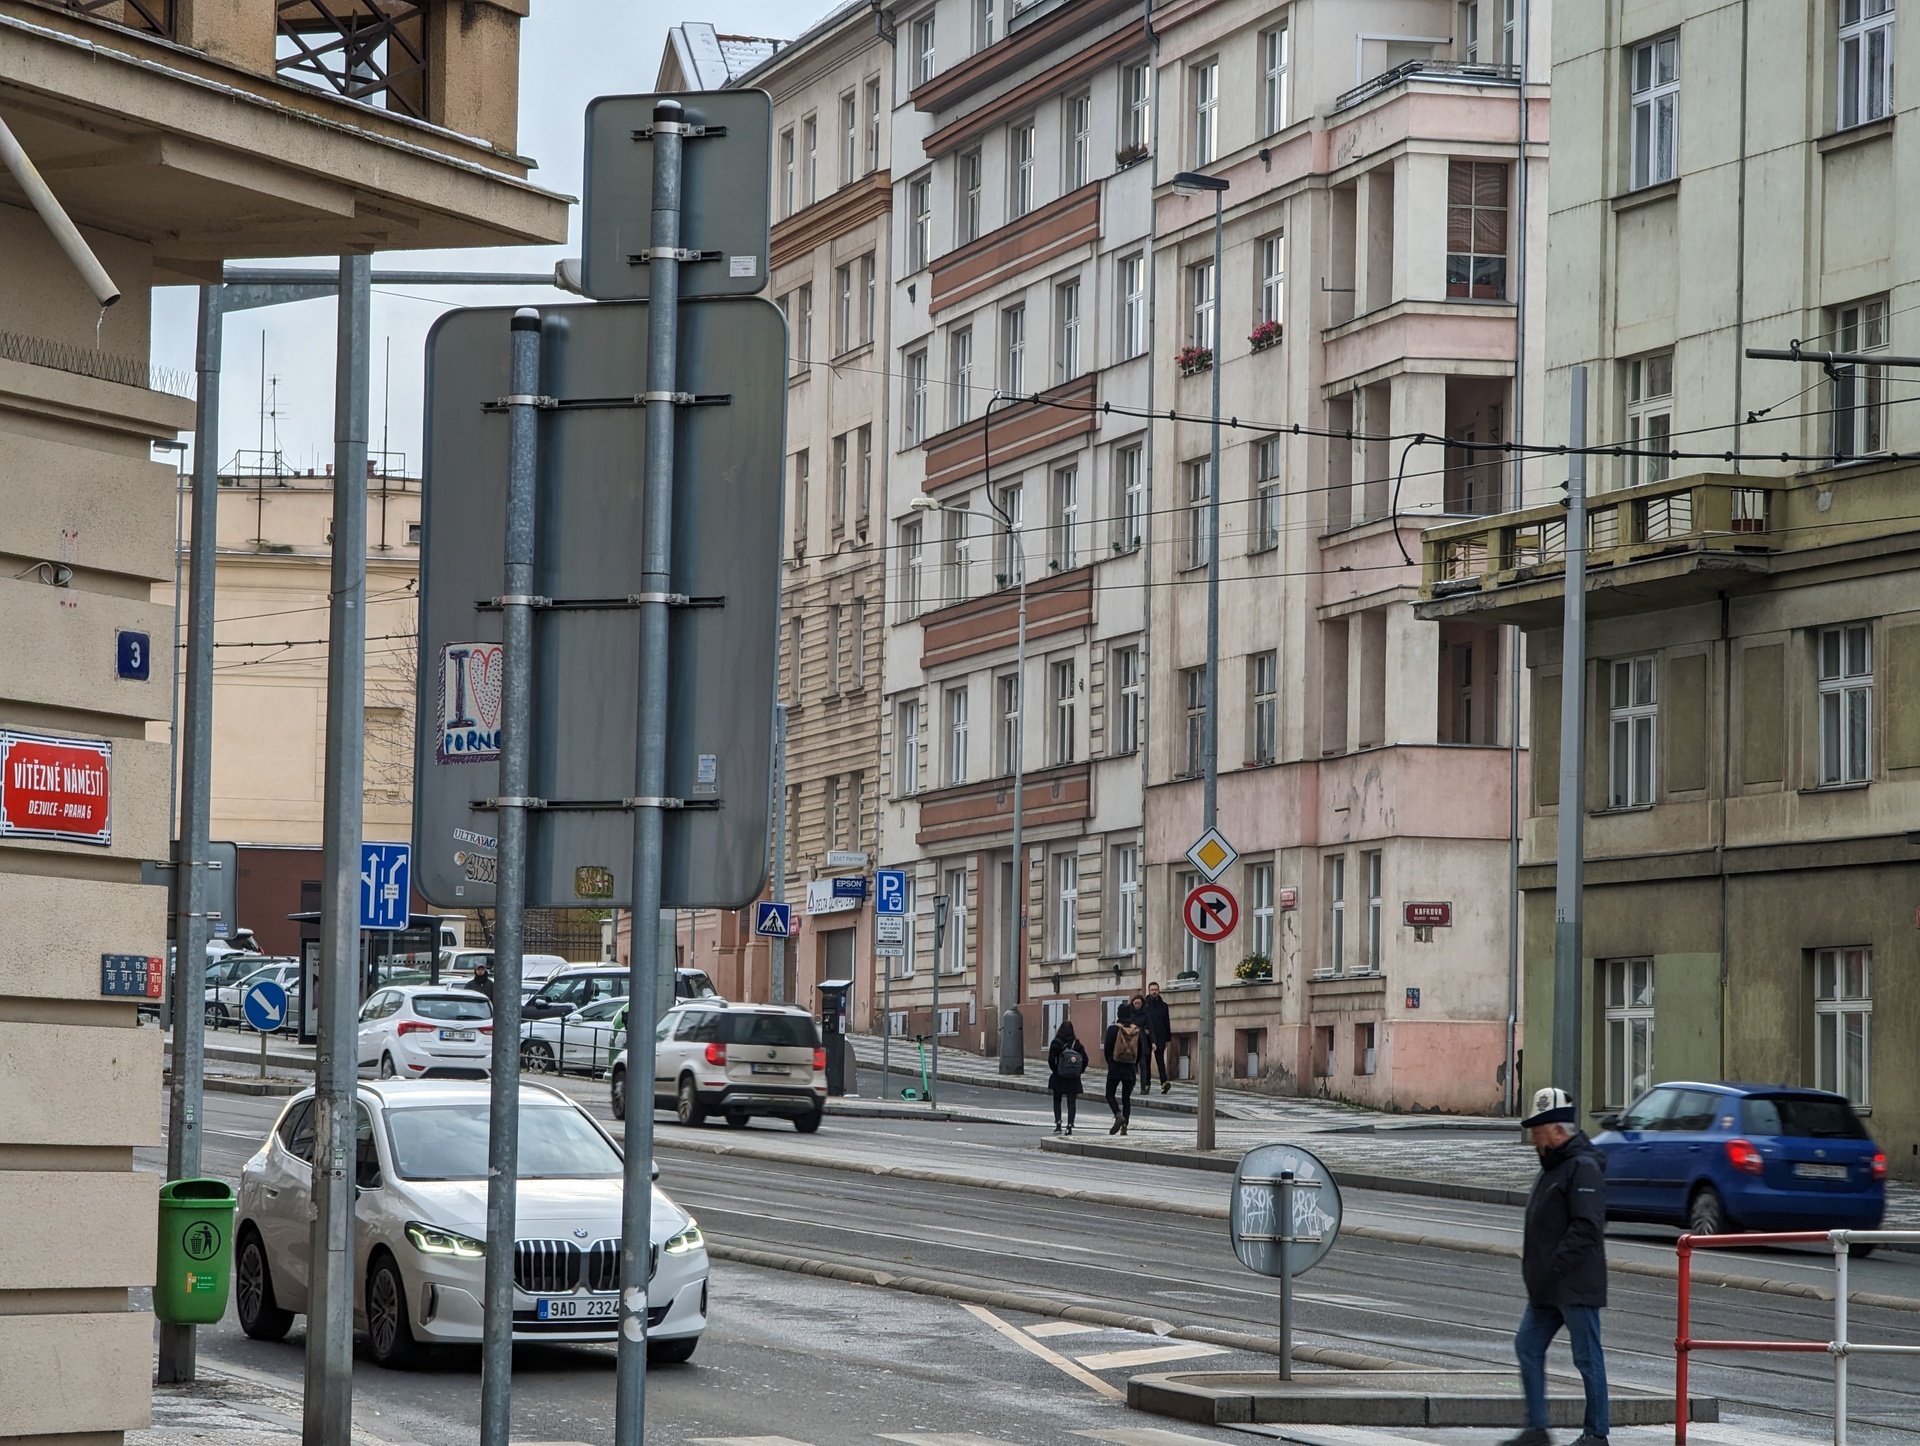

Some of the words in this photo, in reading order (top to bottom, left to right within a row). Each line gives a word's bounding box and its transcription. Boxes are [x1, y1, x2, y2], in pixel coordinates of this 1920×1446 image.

[131, 641, 141, 668] 3
[14, 758, 60, 792] VÍTĚZNÉ
[63, 763, 103, 797] NÁMĚSTÍ
[28, 800, 58, 816] DEJVICE
[63, 803, 85, 819] PRAHA
[86, 805, 92, 820] 6
[836, 880, 862, 888] EPSON
[882, 875, 899, 900] P
[1414, 908, 1443, 916] KAFKOVA
[551, 1301, 577, 1317] 9AD
[587, 1300, 619, 1316] 2324
